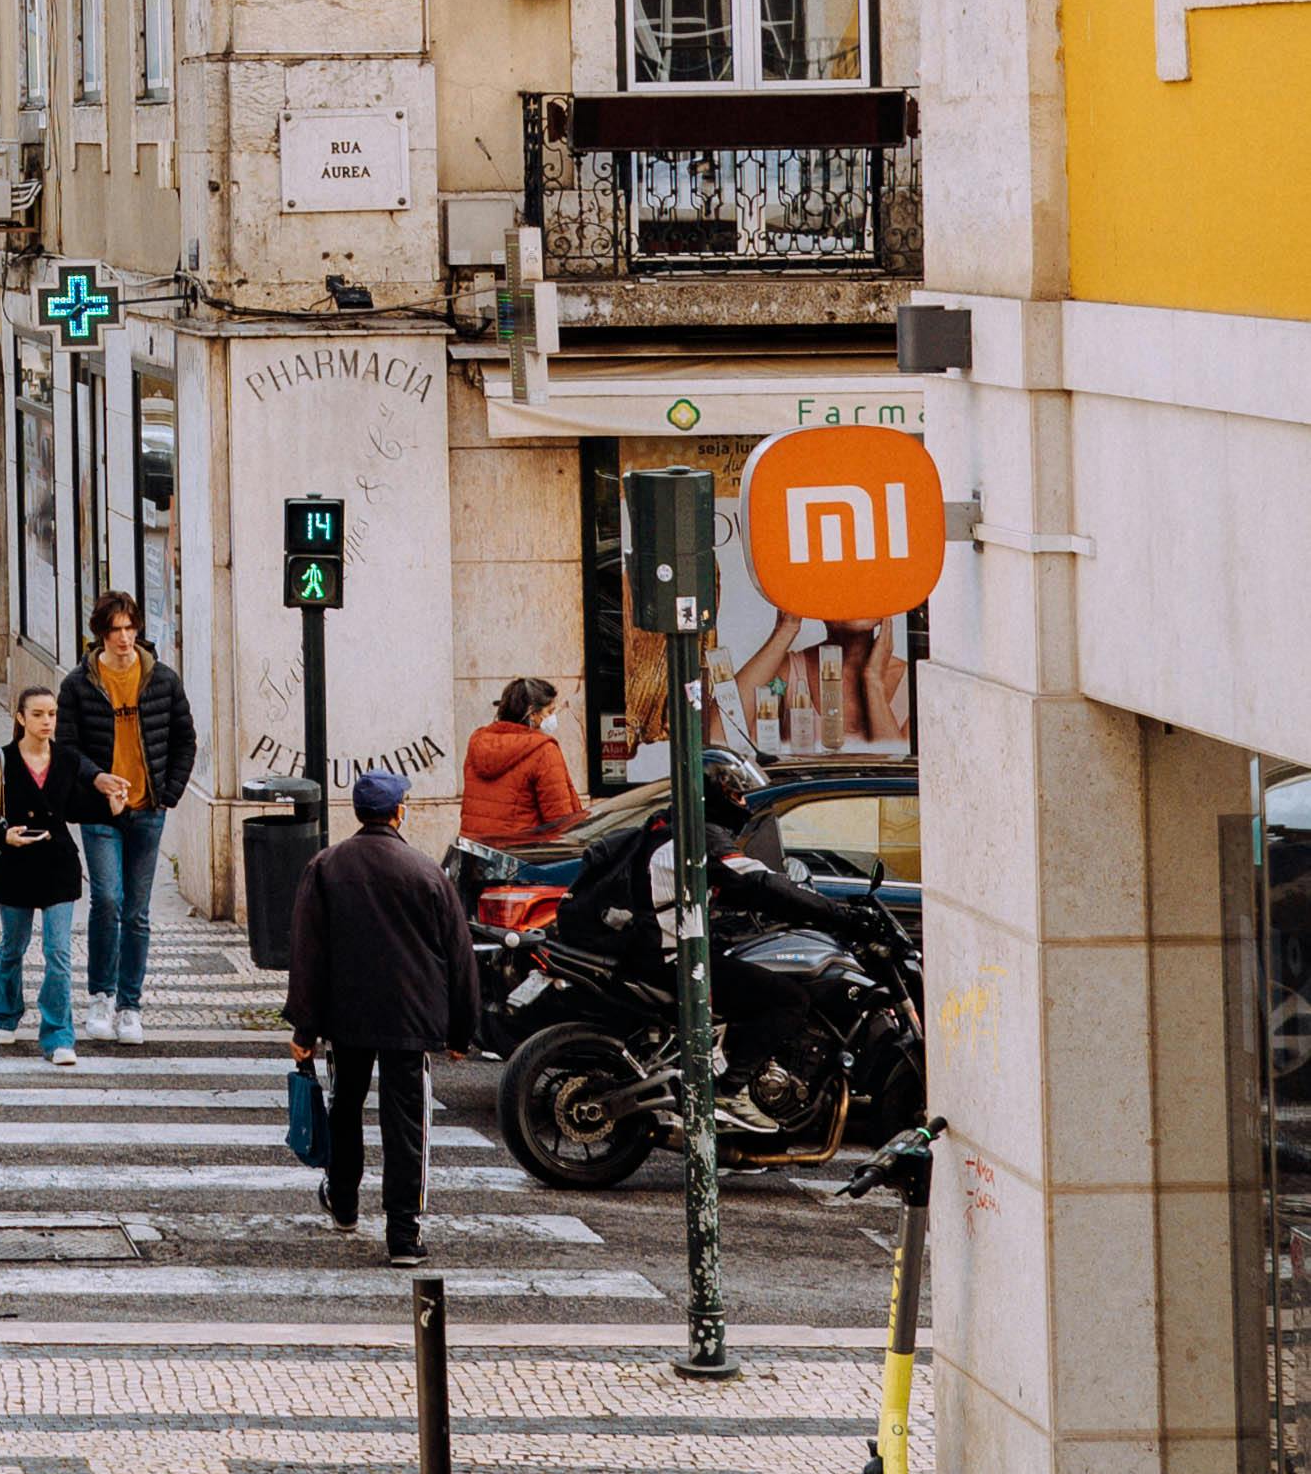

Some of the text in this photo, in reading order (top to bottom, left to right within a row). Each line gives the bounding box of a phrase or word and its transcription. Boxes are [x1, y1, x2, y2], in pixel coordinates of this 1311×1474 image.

[330, 142, 362, 154] RUA
[321, 162, 371, 179] ÁUREA
[307, 512, 331, 540] 14
[249, 734, 446, 789] PERUMARIA
